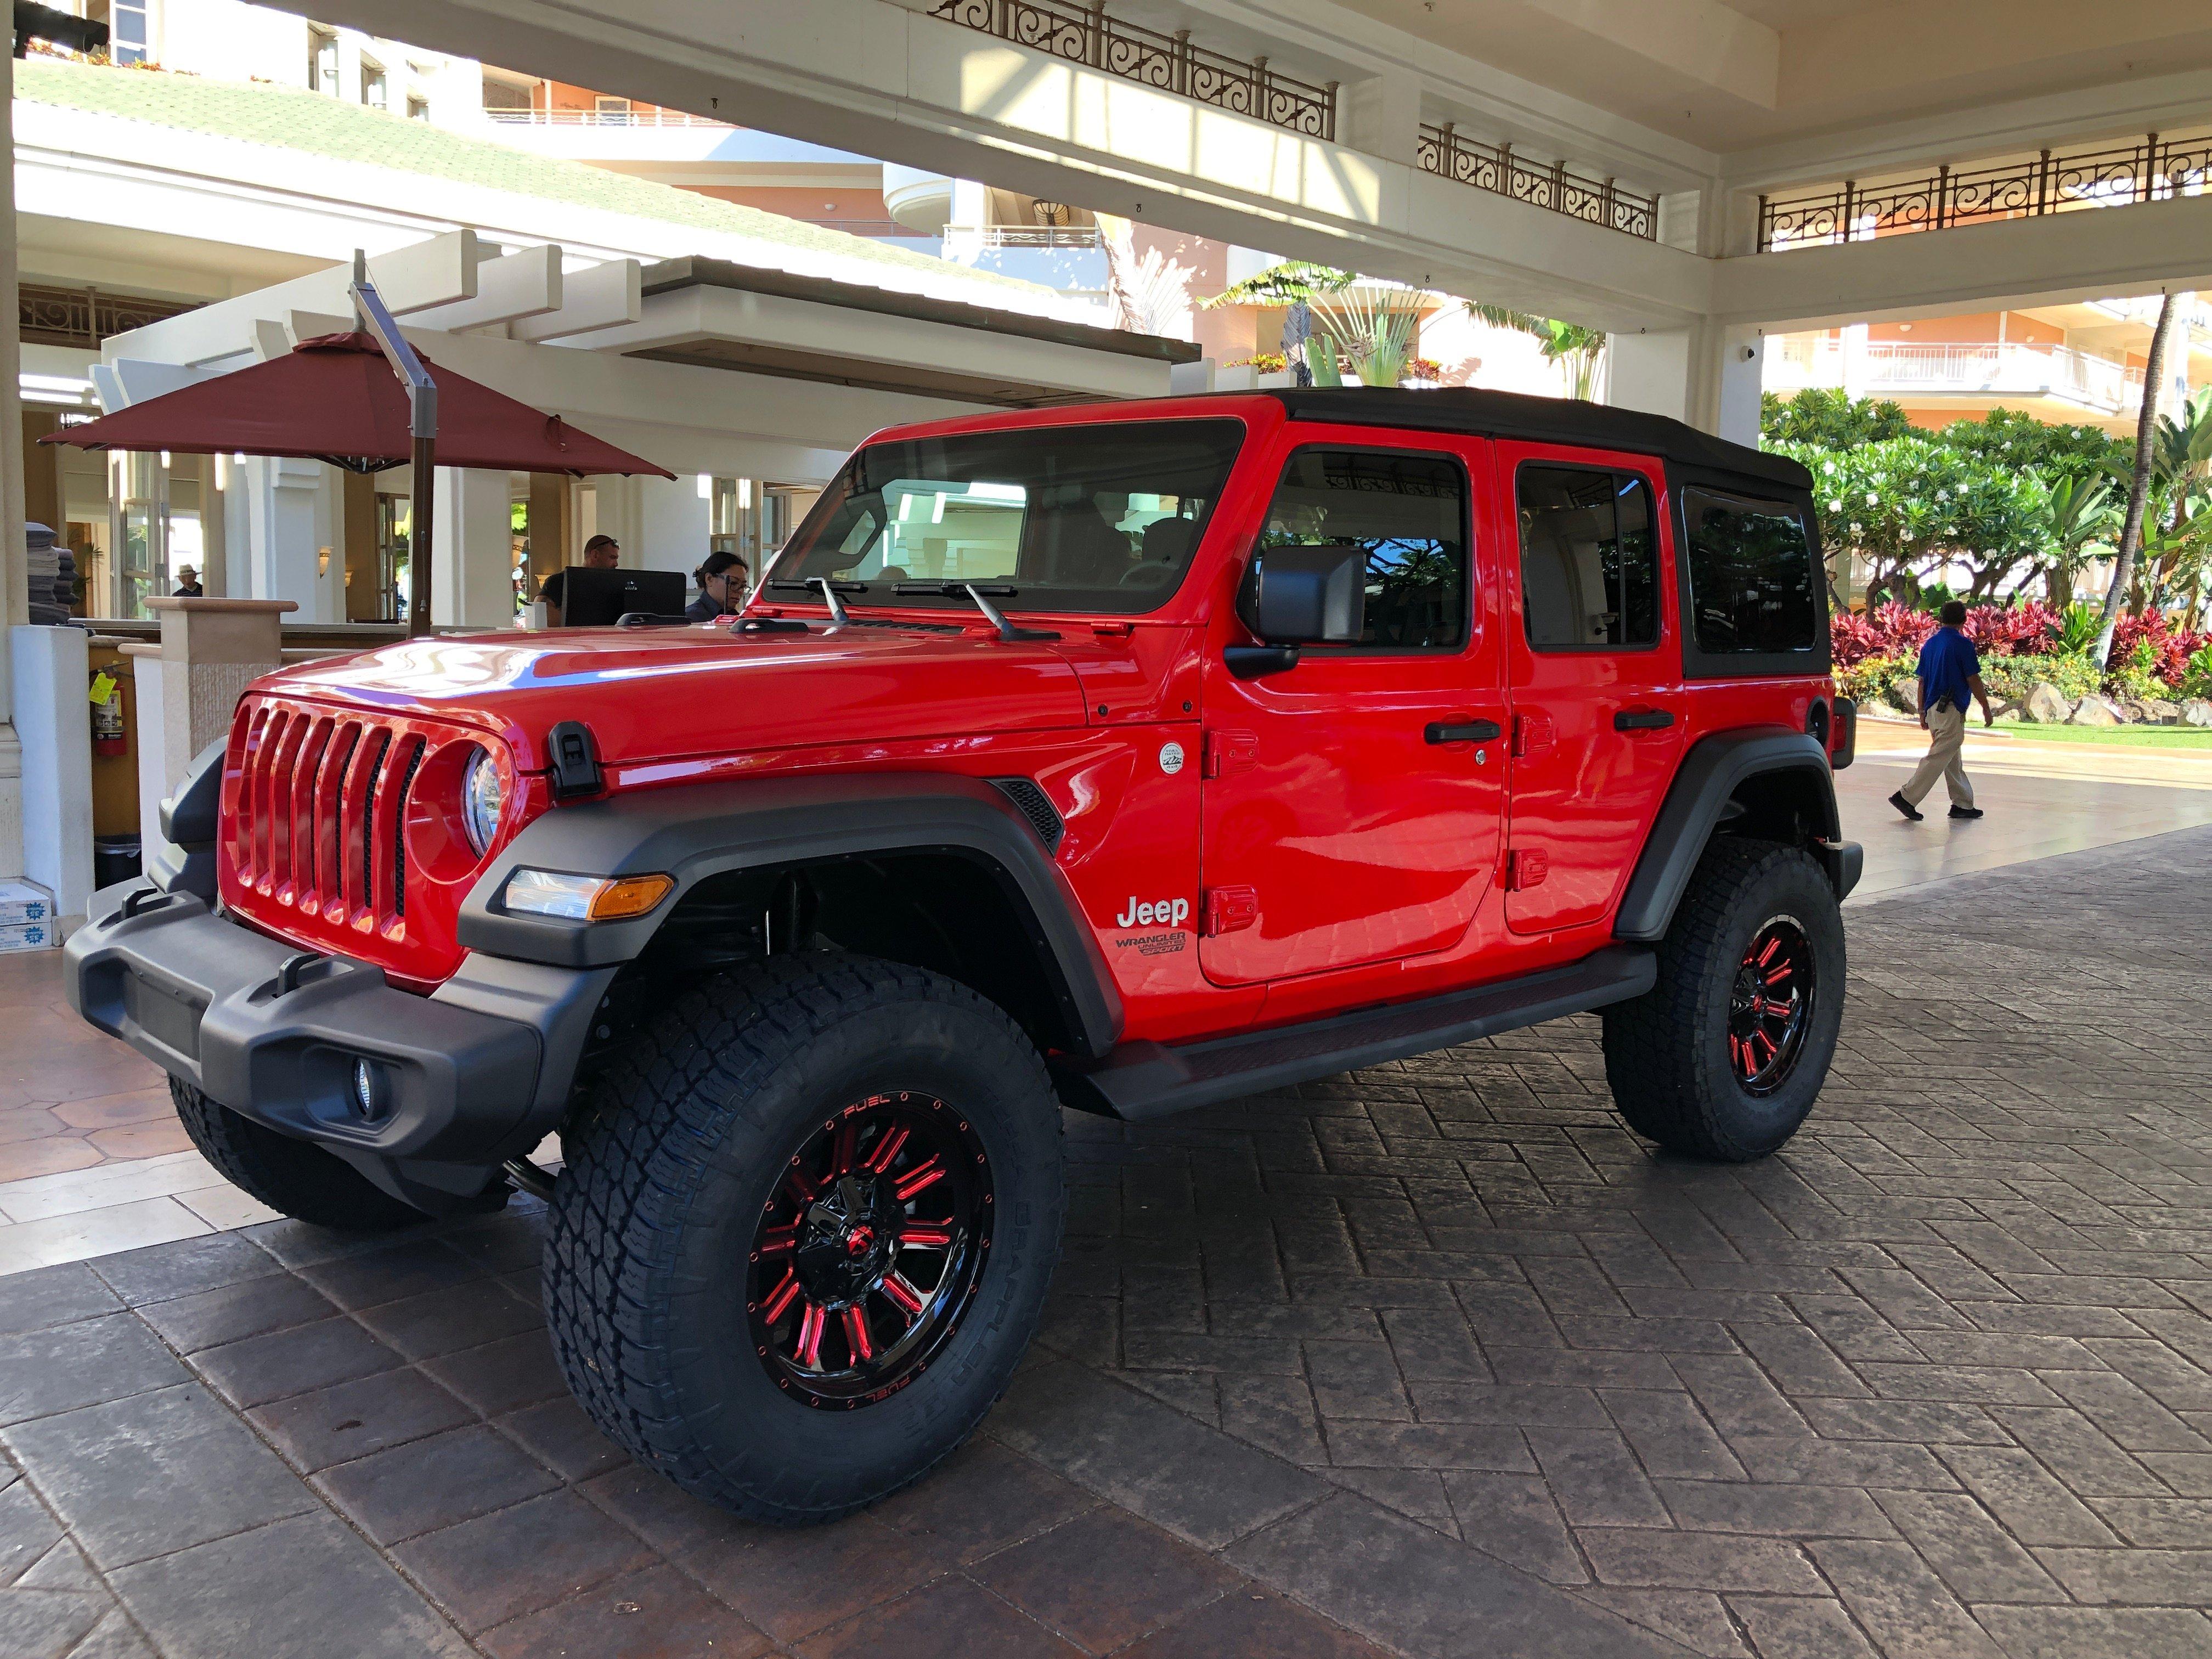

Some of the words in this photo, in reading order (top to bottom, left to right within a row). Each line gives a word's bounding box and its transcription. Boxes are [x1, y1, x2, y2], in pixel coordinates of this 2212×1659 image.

[1116, 896, 1189, 928] Jeep
[1115, 932, 1186, 948] WRANGLER
[1138, 939, 1186, 949] UNLIMITED
[1140, 945, 1184, 955] SPORT
[843, 1094, 890, 1119] FUEL
[951, 1201, 1030, 1386] GRAPPLER
[865, 1374, 911, 1402] FUEL
